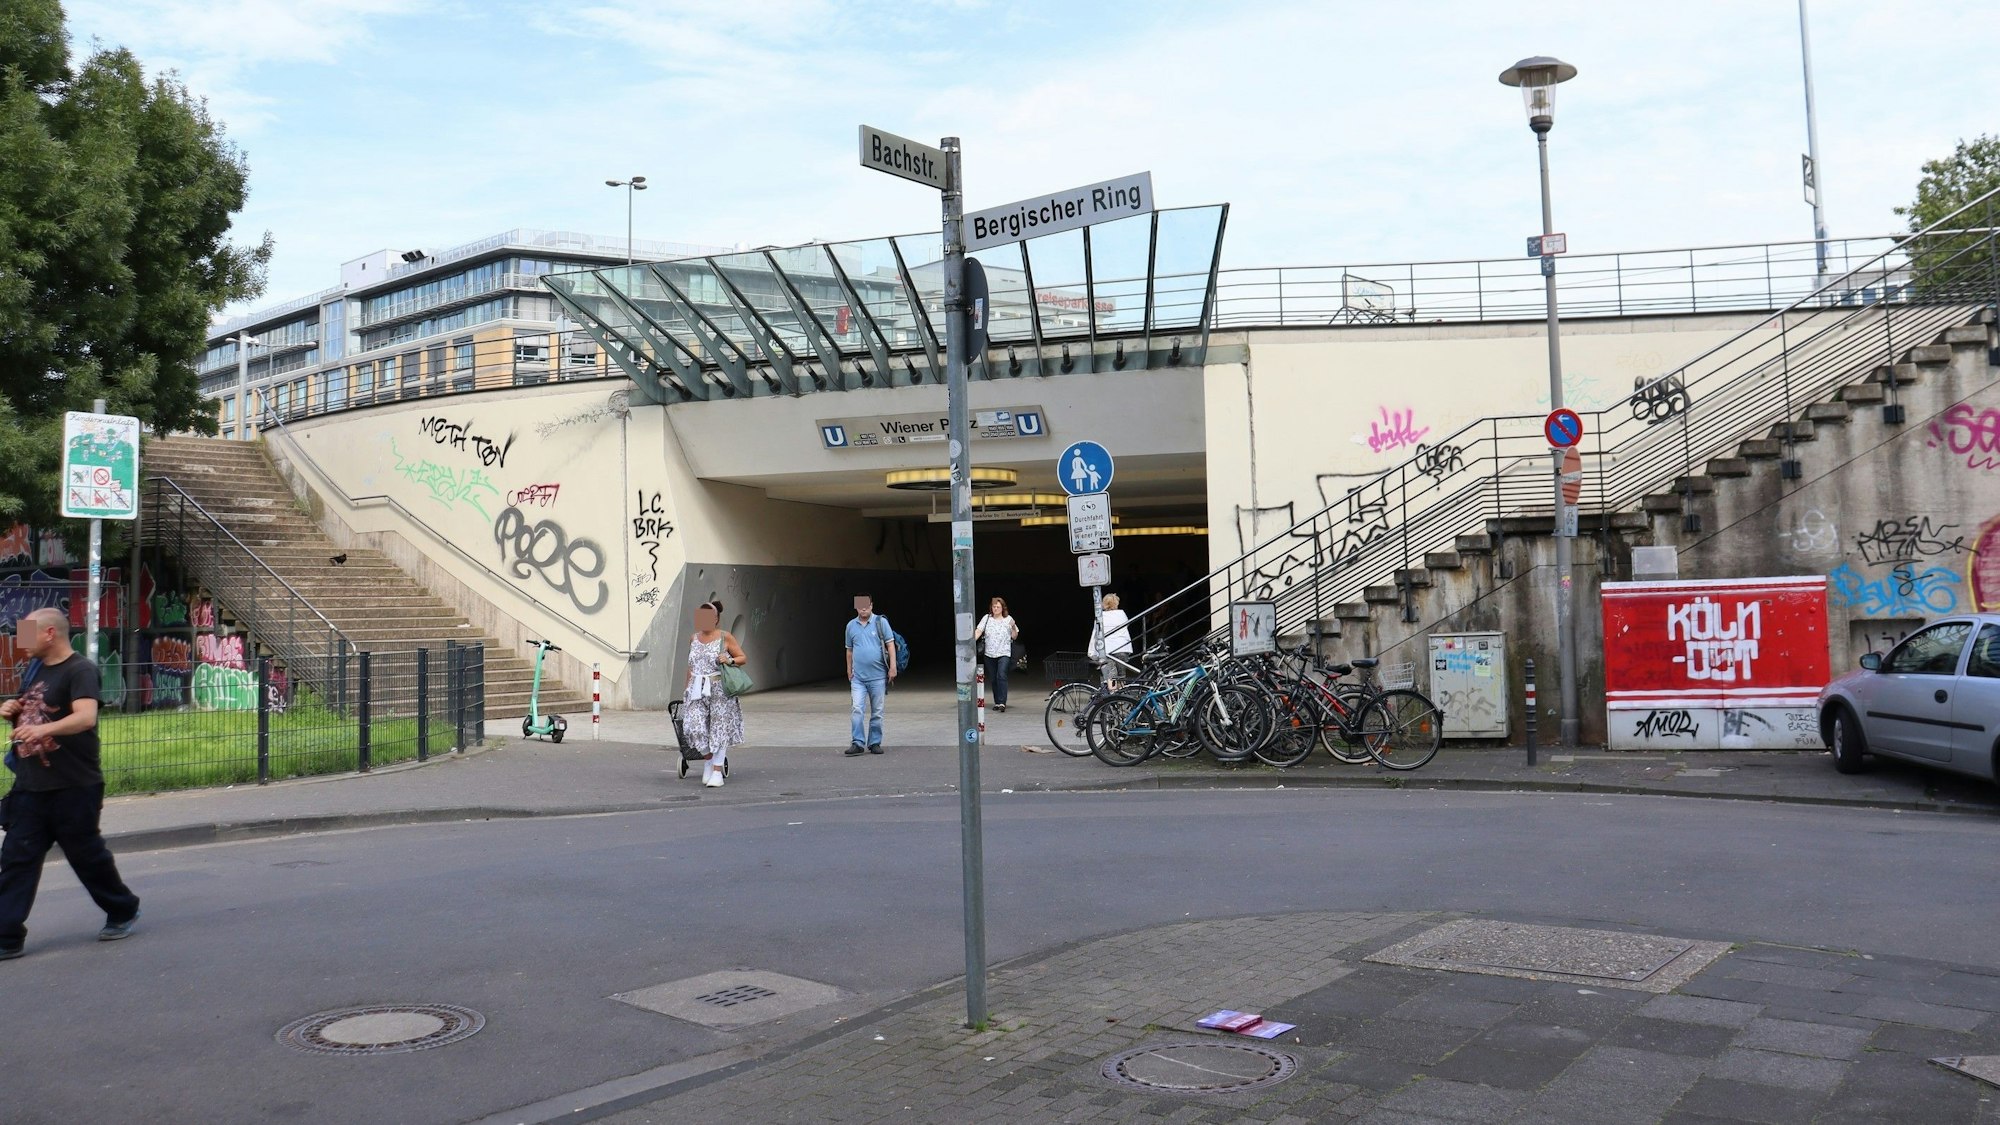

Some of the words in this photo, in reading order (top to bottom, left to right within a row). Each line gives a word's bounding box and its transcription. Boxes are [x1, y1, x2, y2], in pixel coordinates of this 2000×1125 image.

[872, 134, 938, 180] Bachstr.
[974, 197, 1084, 239] Bergischer
[1092, 184, 1141, 212] Ring
[880, 420, 934, 434] Wiener
[1018, 414, 1039, 435] U
[824, 427, 845, 446] U
[1074, 514, 1104, 523] Durchfahrt
